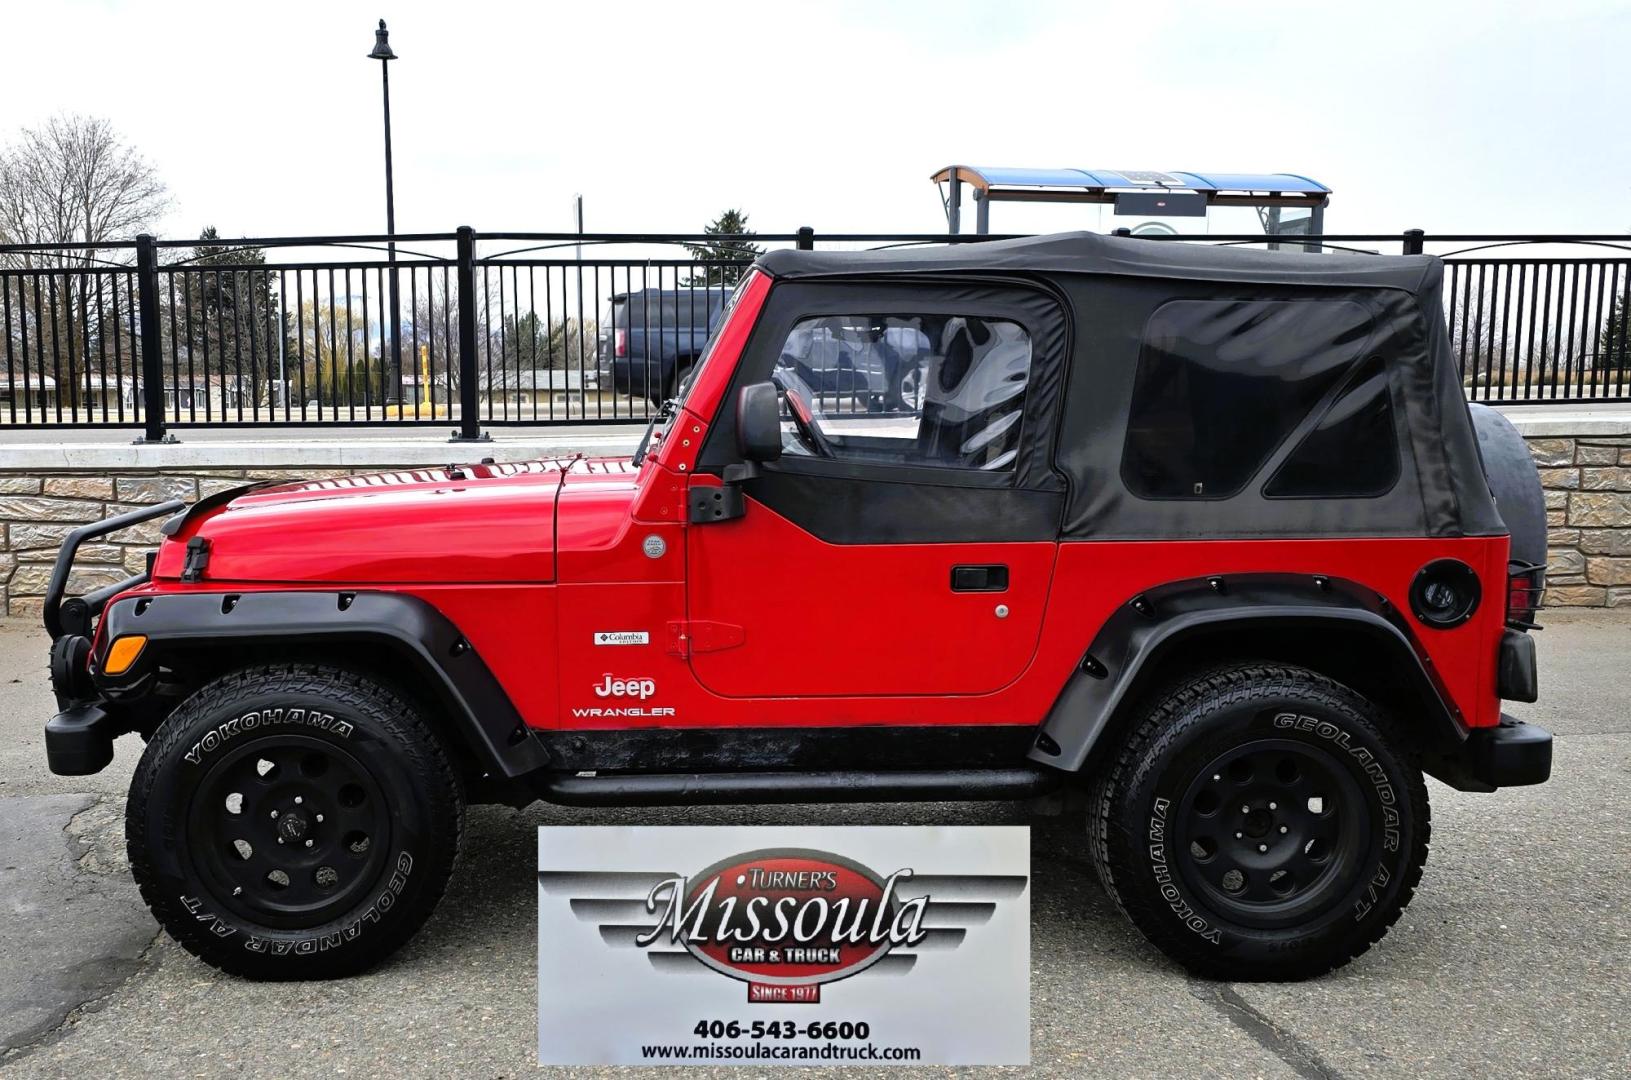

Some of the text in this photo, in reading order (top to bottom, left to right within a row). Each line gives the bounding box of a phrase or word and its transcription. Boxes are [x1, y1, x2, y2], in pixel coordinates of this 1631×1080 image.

[609, 633, 643, 641] Columbia
[572, 707, 675, 717] WRANGLER
[594, 675, 655, 699] Jeep
[184, 708, 354, 765] YOKOHAMA
[1273, 712, 1400, 922] GEOLANDAR A/T
[1150, 797, 1223, 945] YOKOHAMA
[180, 850, 413, 955] GEOLANDAR A/T
